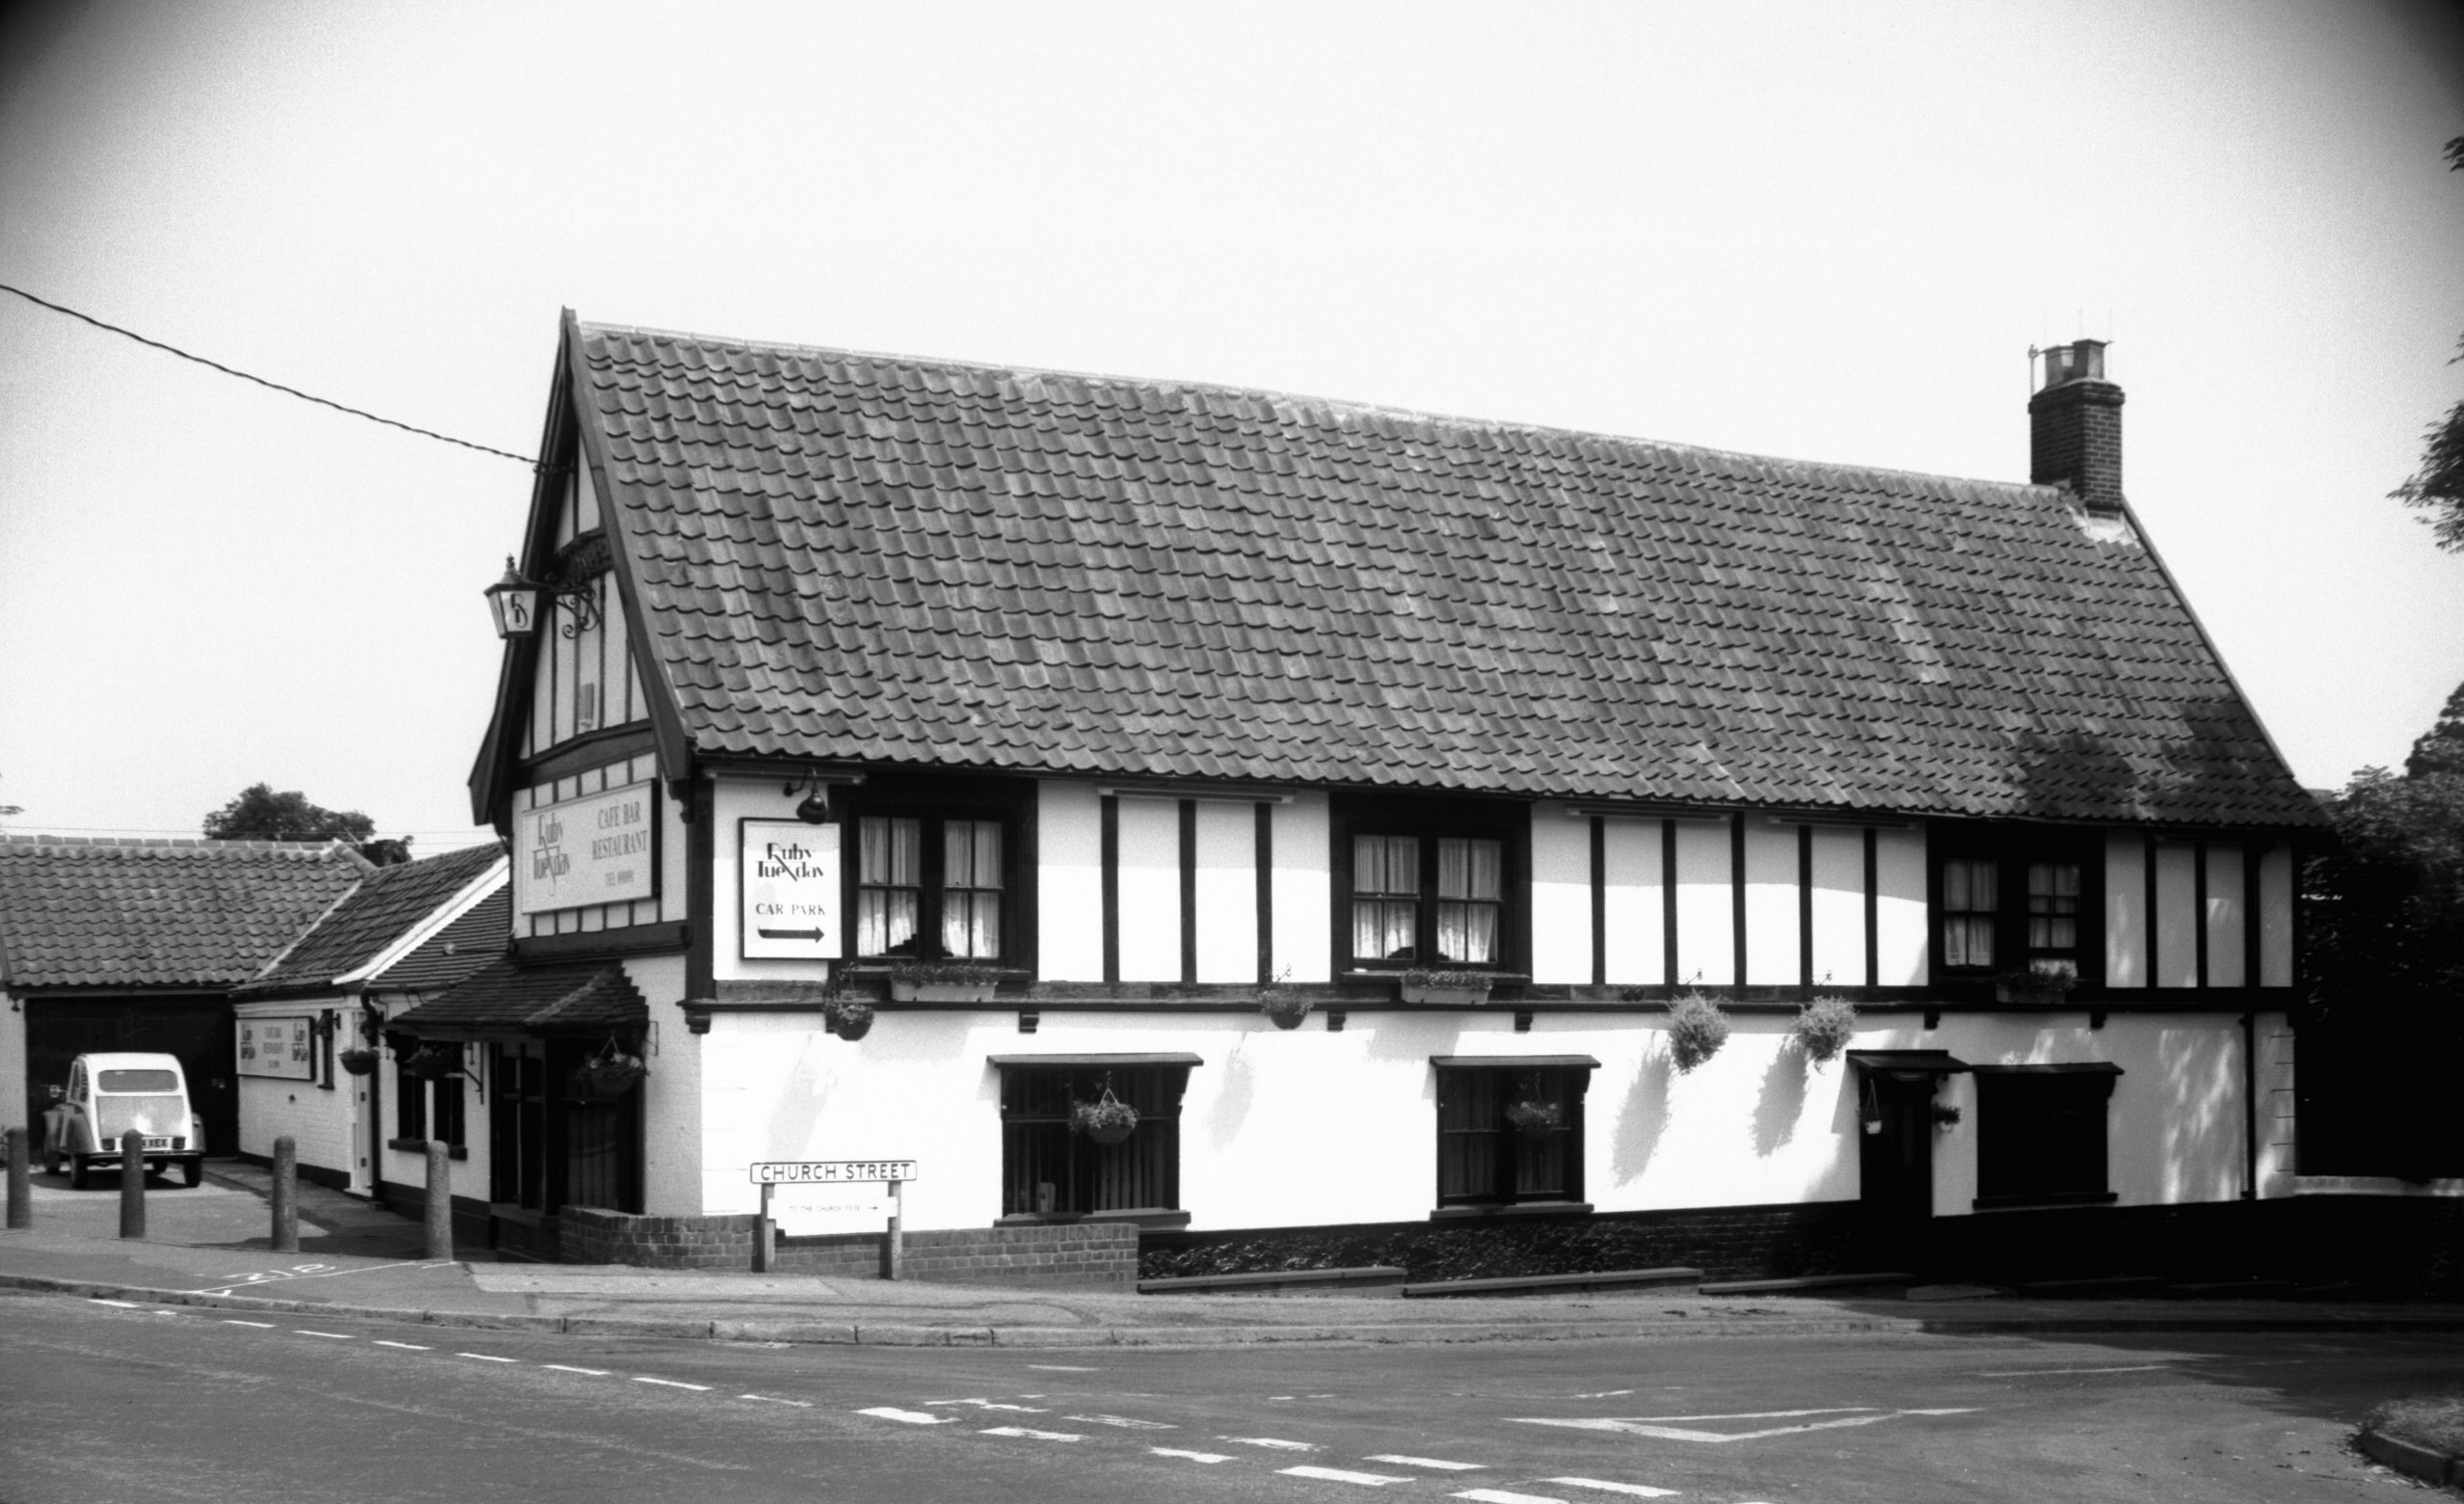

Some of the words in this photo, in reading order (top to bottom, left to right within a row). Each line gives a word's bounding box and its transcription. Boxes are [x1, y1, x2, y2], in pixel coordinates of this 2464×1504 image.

[624, 801, 641, 825] BAR
[592, 830, 648, 860] RESTAURANT
[767, 843, 812, 864] Ruby
[756, 903, 784, 915] CAR
[791, 903, 826, 916] PARK
[761, 1165, 837, 1181] CHURCH
[845, 1163, 910, 1179] STREET
